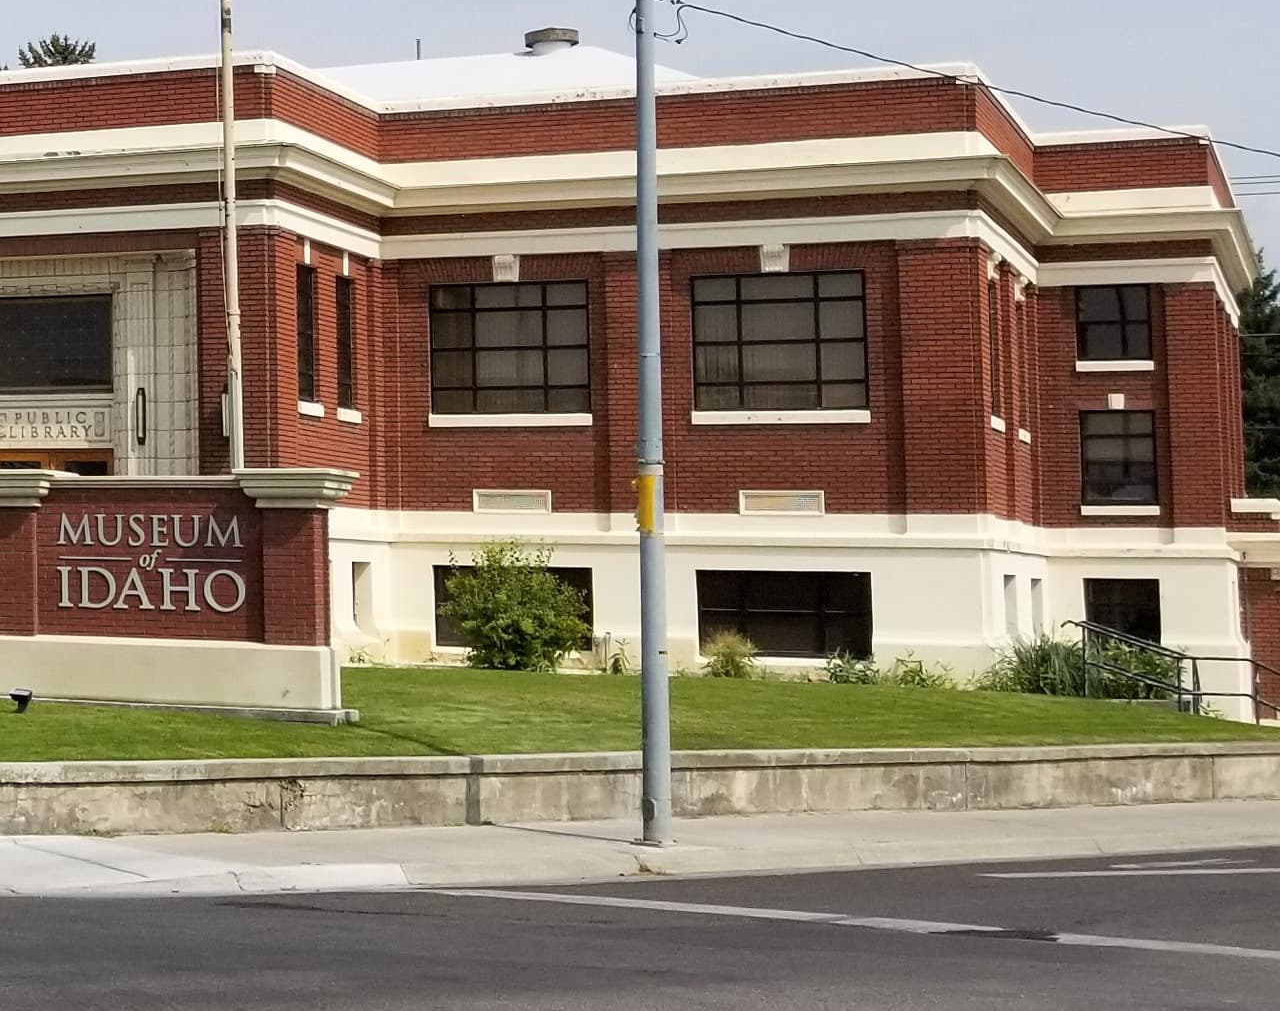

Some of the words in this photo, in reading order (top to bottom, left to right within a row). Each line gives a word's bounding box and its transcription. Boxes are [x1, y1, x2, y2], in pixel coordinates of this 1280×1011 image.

[15, 411, 87, 424] PUBLIC
[9, 425, 92, 438] LIBRARY
[57, 512, 244, 547] MUSEUM
[139, 549, 162, 570] of
[57, 566, 246, 612] IDAHO
